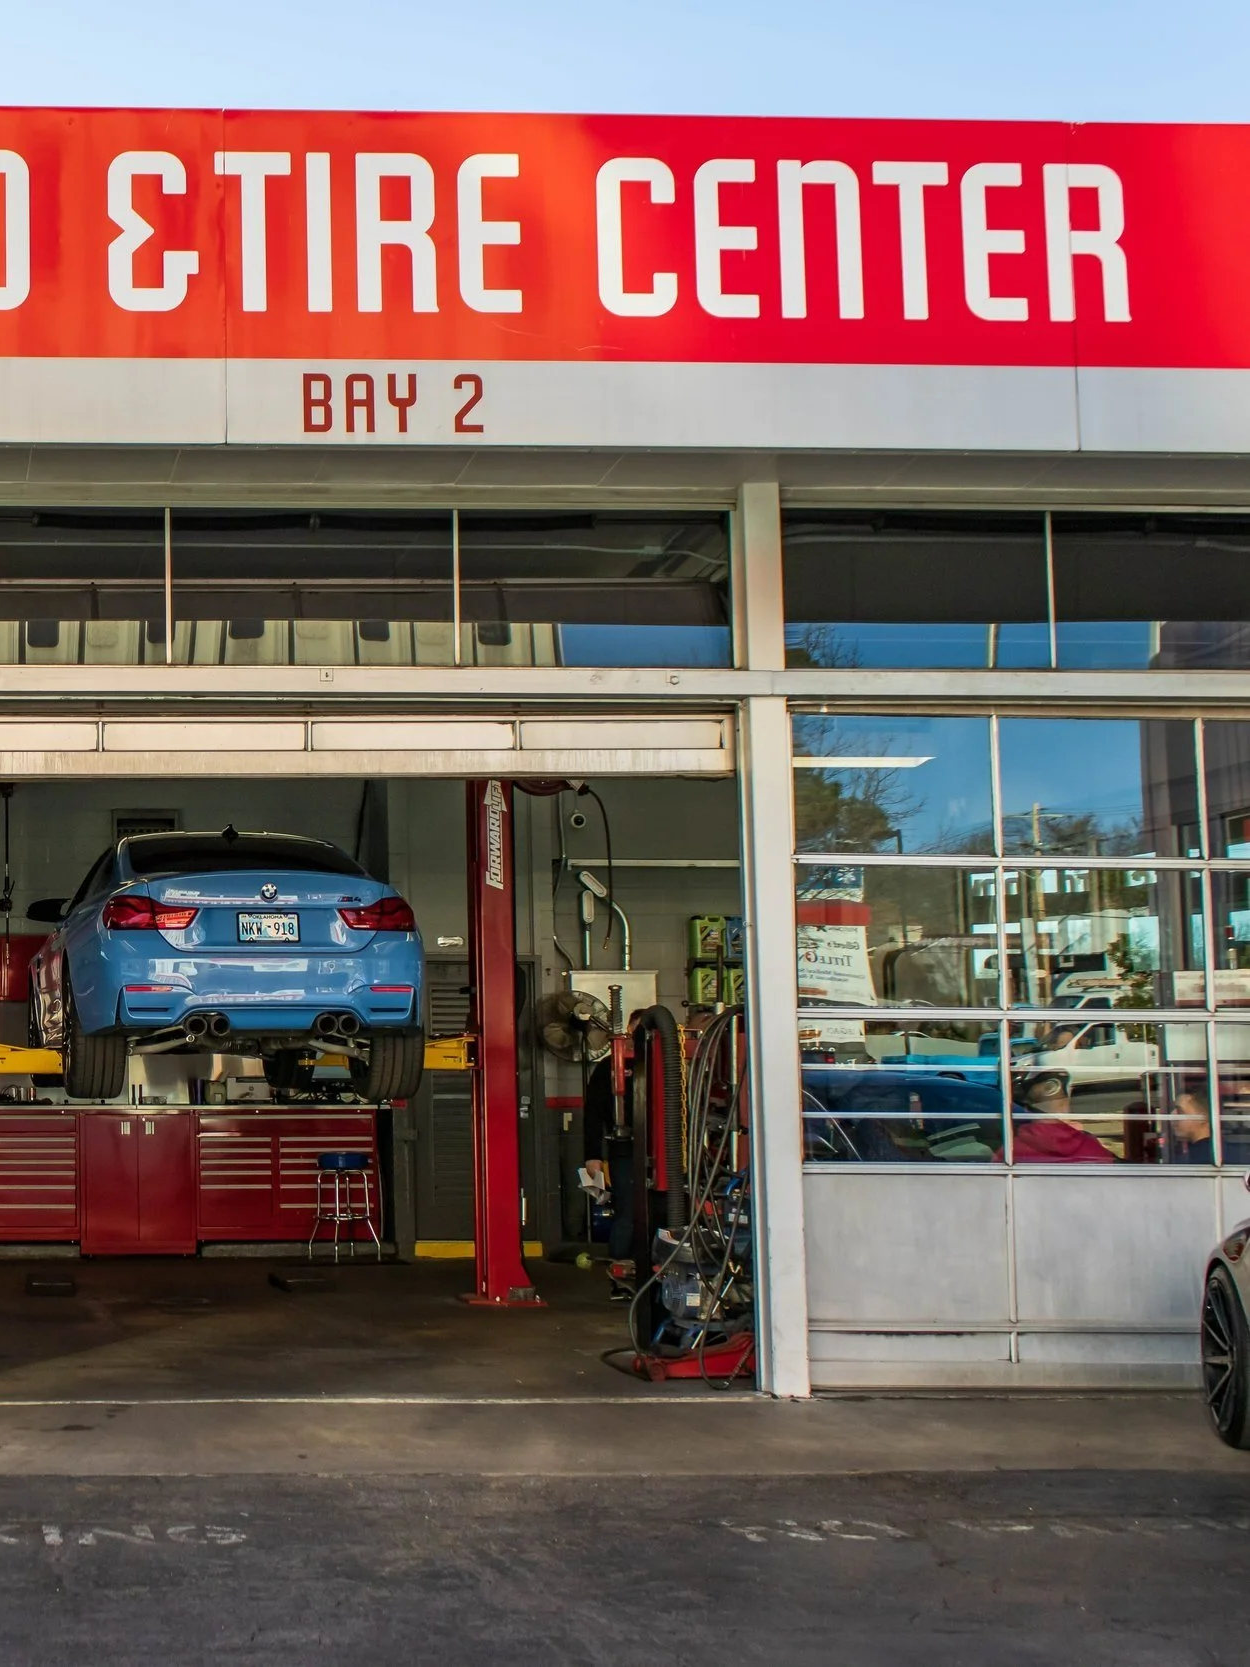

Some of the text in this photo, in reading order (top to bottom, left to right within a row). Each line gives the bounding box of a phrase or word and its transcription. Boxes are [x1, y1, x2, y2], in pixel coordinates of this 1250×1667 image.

[595, 157, 1132, 323] CENTER
[301, 372, 484, 434] BAY 2
